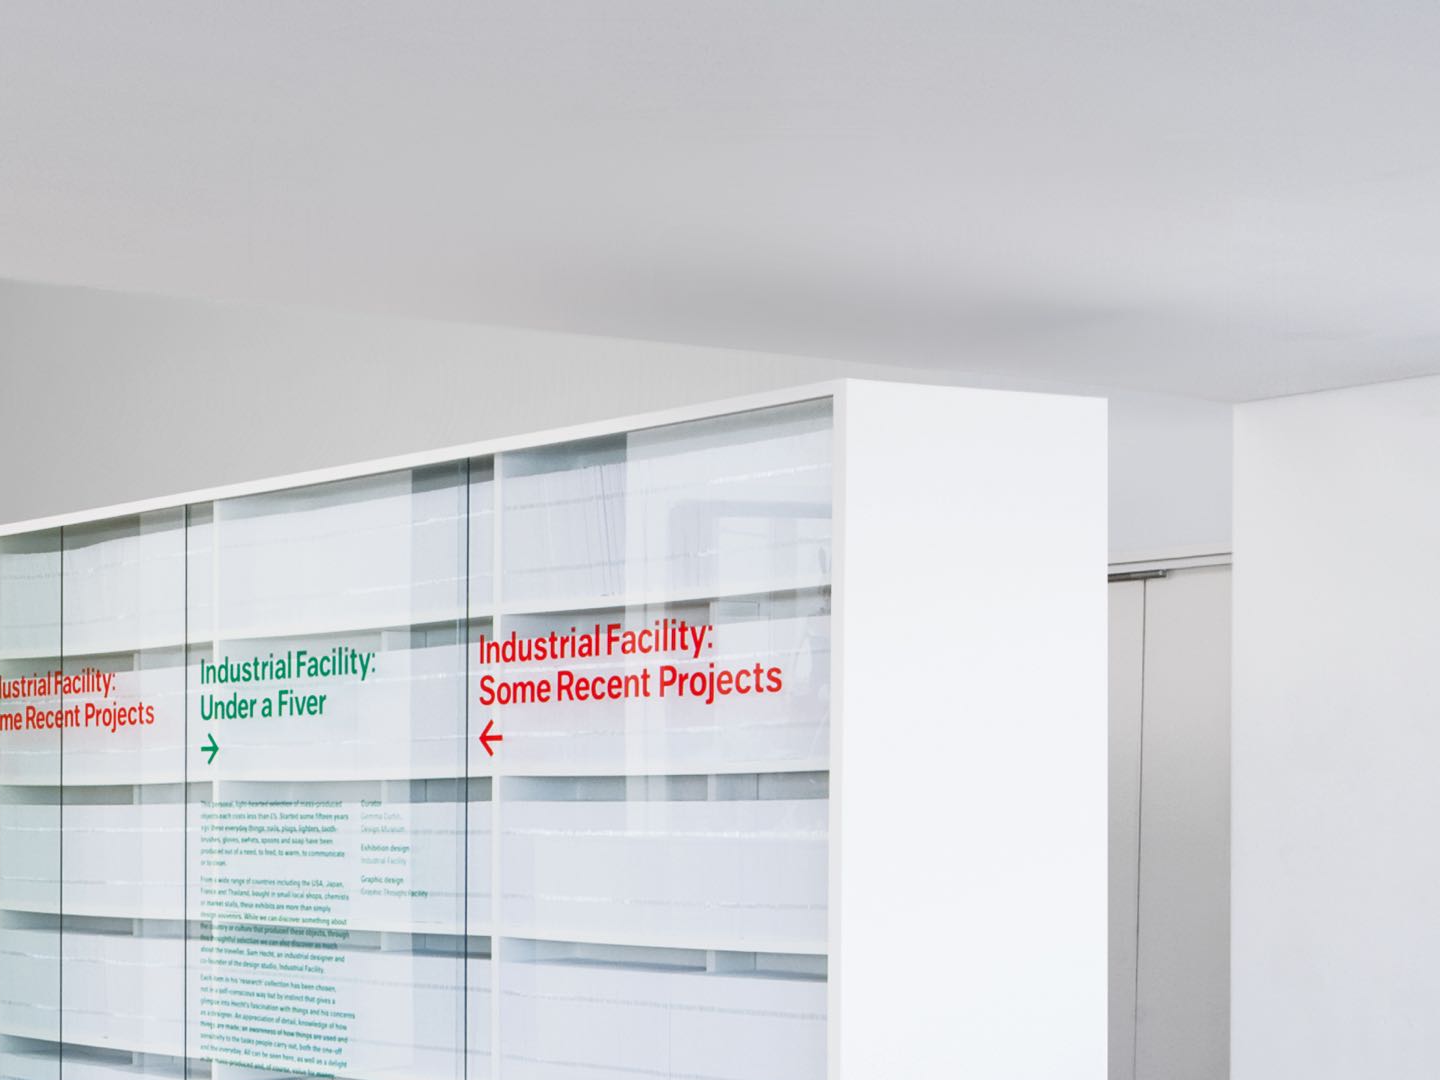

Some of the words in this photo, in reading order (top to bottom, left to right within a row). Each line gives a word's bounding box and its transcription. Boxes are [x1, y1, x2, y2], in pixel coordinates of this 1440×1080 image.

[479, 625, 599, 664] Industrial
[607, 618, 713, 658] Facility:
[55, 667, 116, 697] Facility:
[201, 650, 291, 684] Industrial
[296, 646, 375, 681] Facility:
[479, 675, 550, 706] Some
[557, 668, 649, 701] Recent
[659, 662, 783, 705] Projects
[26, 704, 80, 729] Recent
[85, 701, 154, 733] Projects
[201, 691, 256, 720] Under
[261, 697, 272, 717] a
[278, 689, 326, 716] Fiver
